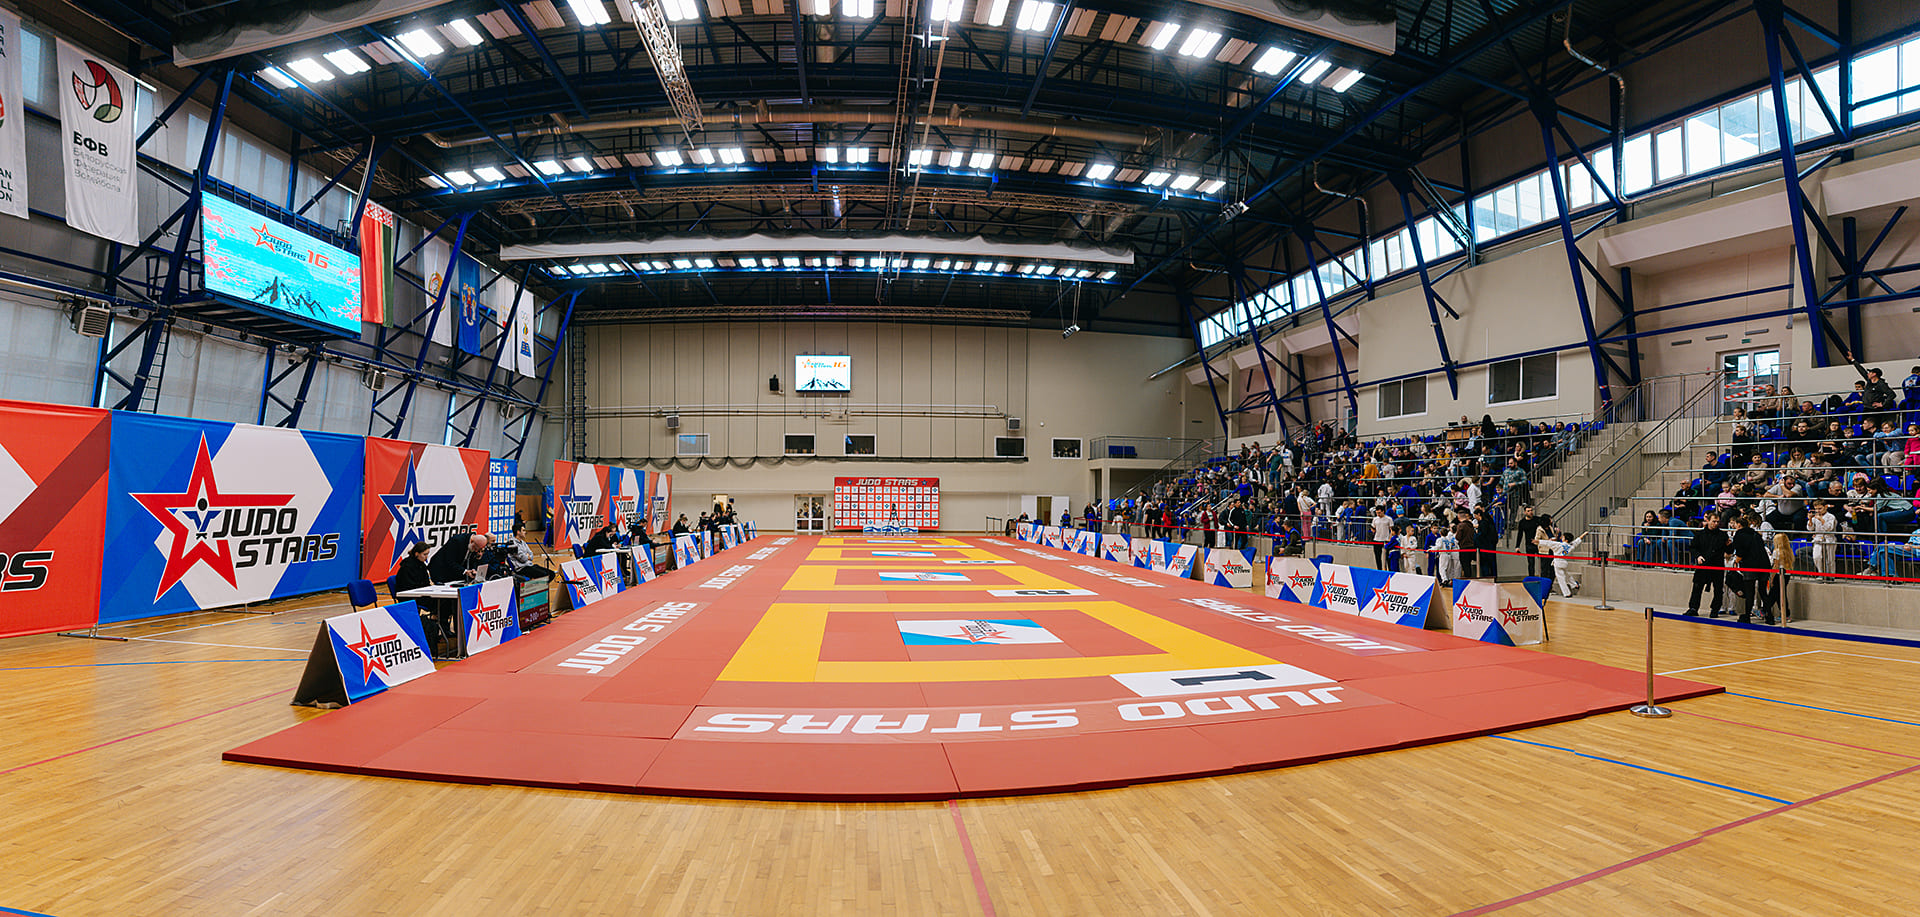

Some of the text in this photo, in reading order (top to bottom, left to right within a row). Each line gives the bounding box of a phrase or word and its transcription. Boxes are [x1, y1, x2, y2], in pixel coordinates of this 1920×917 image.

[73, 130, 108, 157] БФВ
[275, 245, 306, 261] STARS
[307, 249, 330, 269] 16
[416, 505, 456, 527] JUDO
[574, 502, 594, 516] JUDO
[212, 507, 298, 539] JUDO
[579, 515, 604, 530] STARS
[235, 533, 340, 569] STARS
[1330, 586, 1349, 596] JUDO
[1332, 594, 1358, 606] STARS
[1387, 594, 1408, 605] JUDO
[483, 608, 502, 623] JUDO
[1389, 603, 1421, 616] STARS
[1511, 609, 1529, 617] JUDO
[489, 616, 513, 632] STARS
[1179, 598, 1407, 652] JUDO STARS
[1471, 614, 1494, 622] STARS
[1516, 614, 1540, 622] STARS
[557, 601, 698, 674] JUDO STARS
[373, 638, 403, 659] JUDO
[385, 647, 422, 669] STARS
[1174, 669, 1277, 687] 1
[698, 685, 1346, 734] JUDO STARS
